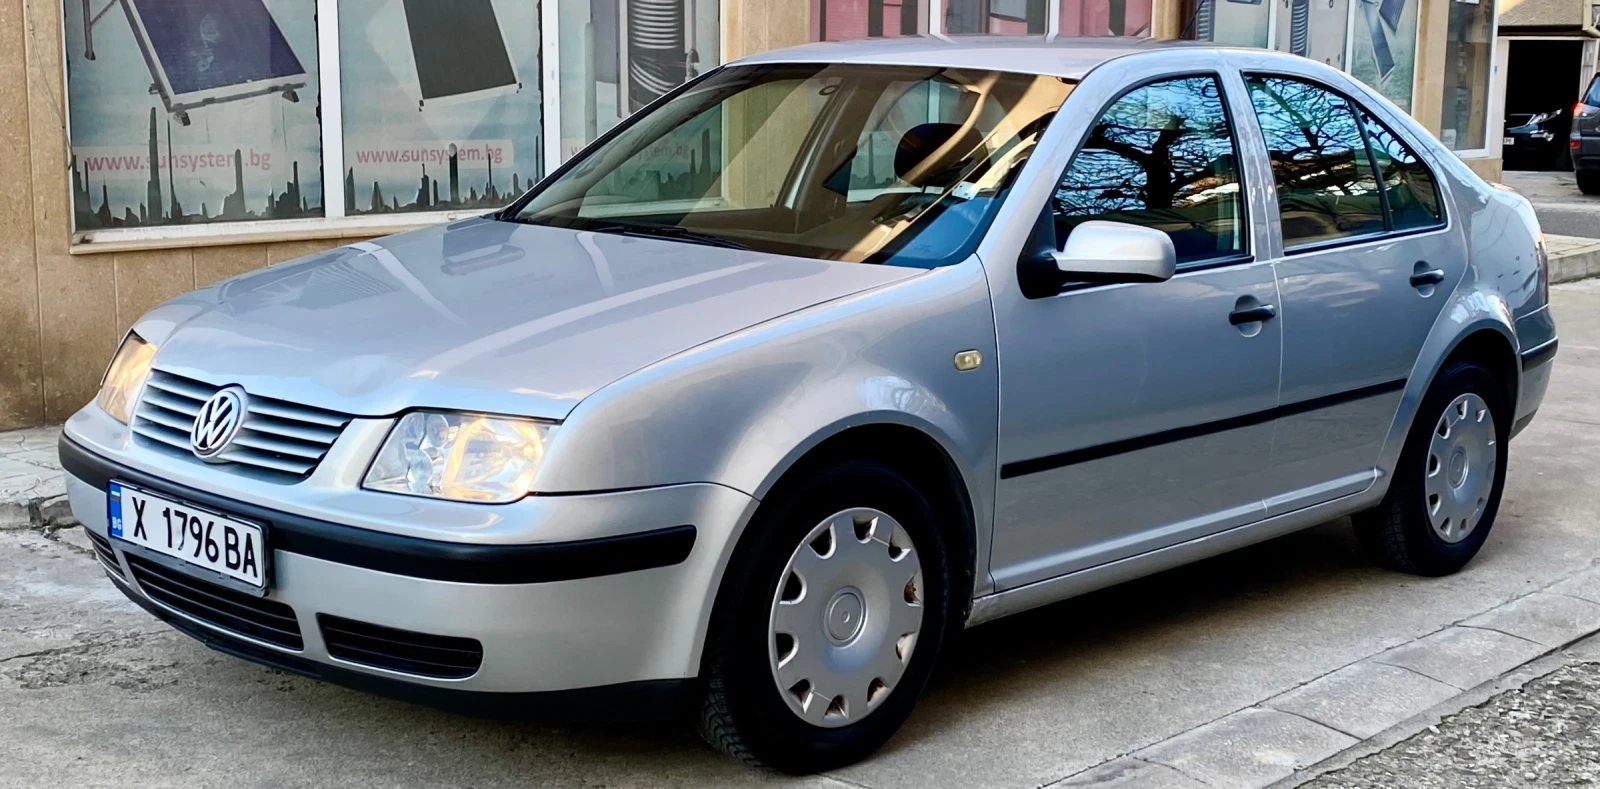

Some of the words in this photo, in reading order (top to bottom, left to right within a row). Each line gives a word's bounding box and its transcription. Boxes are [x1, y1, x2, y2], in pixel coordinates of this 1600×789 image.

[356, 143, 502, 165] www.sunsysem.bg
[191, 389, 242, 457] VW
[112, 516, 122, 530] BG
[131, 496, 148, 541] X
